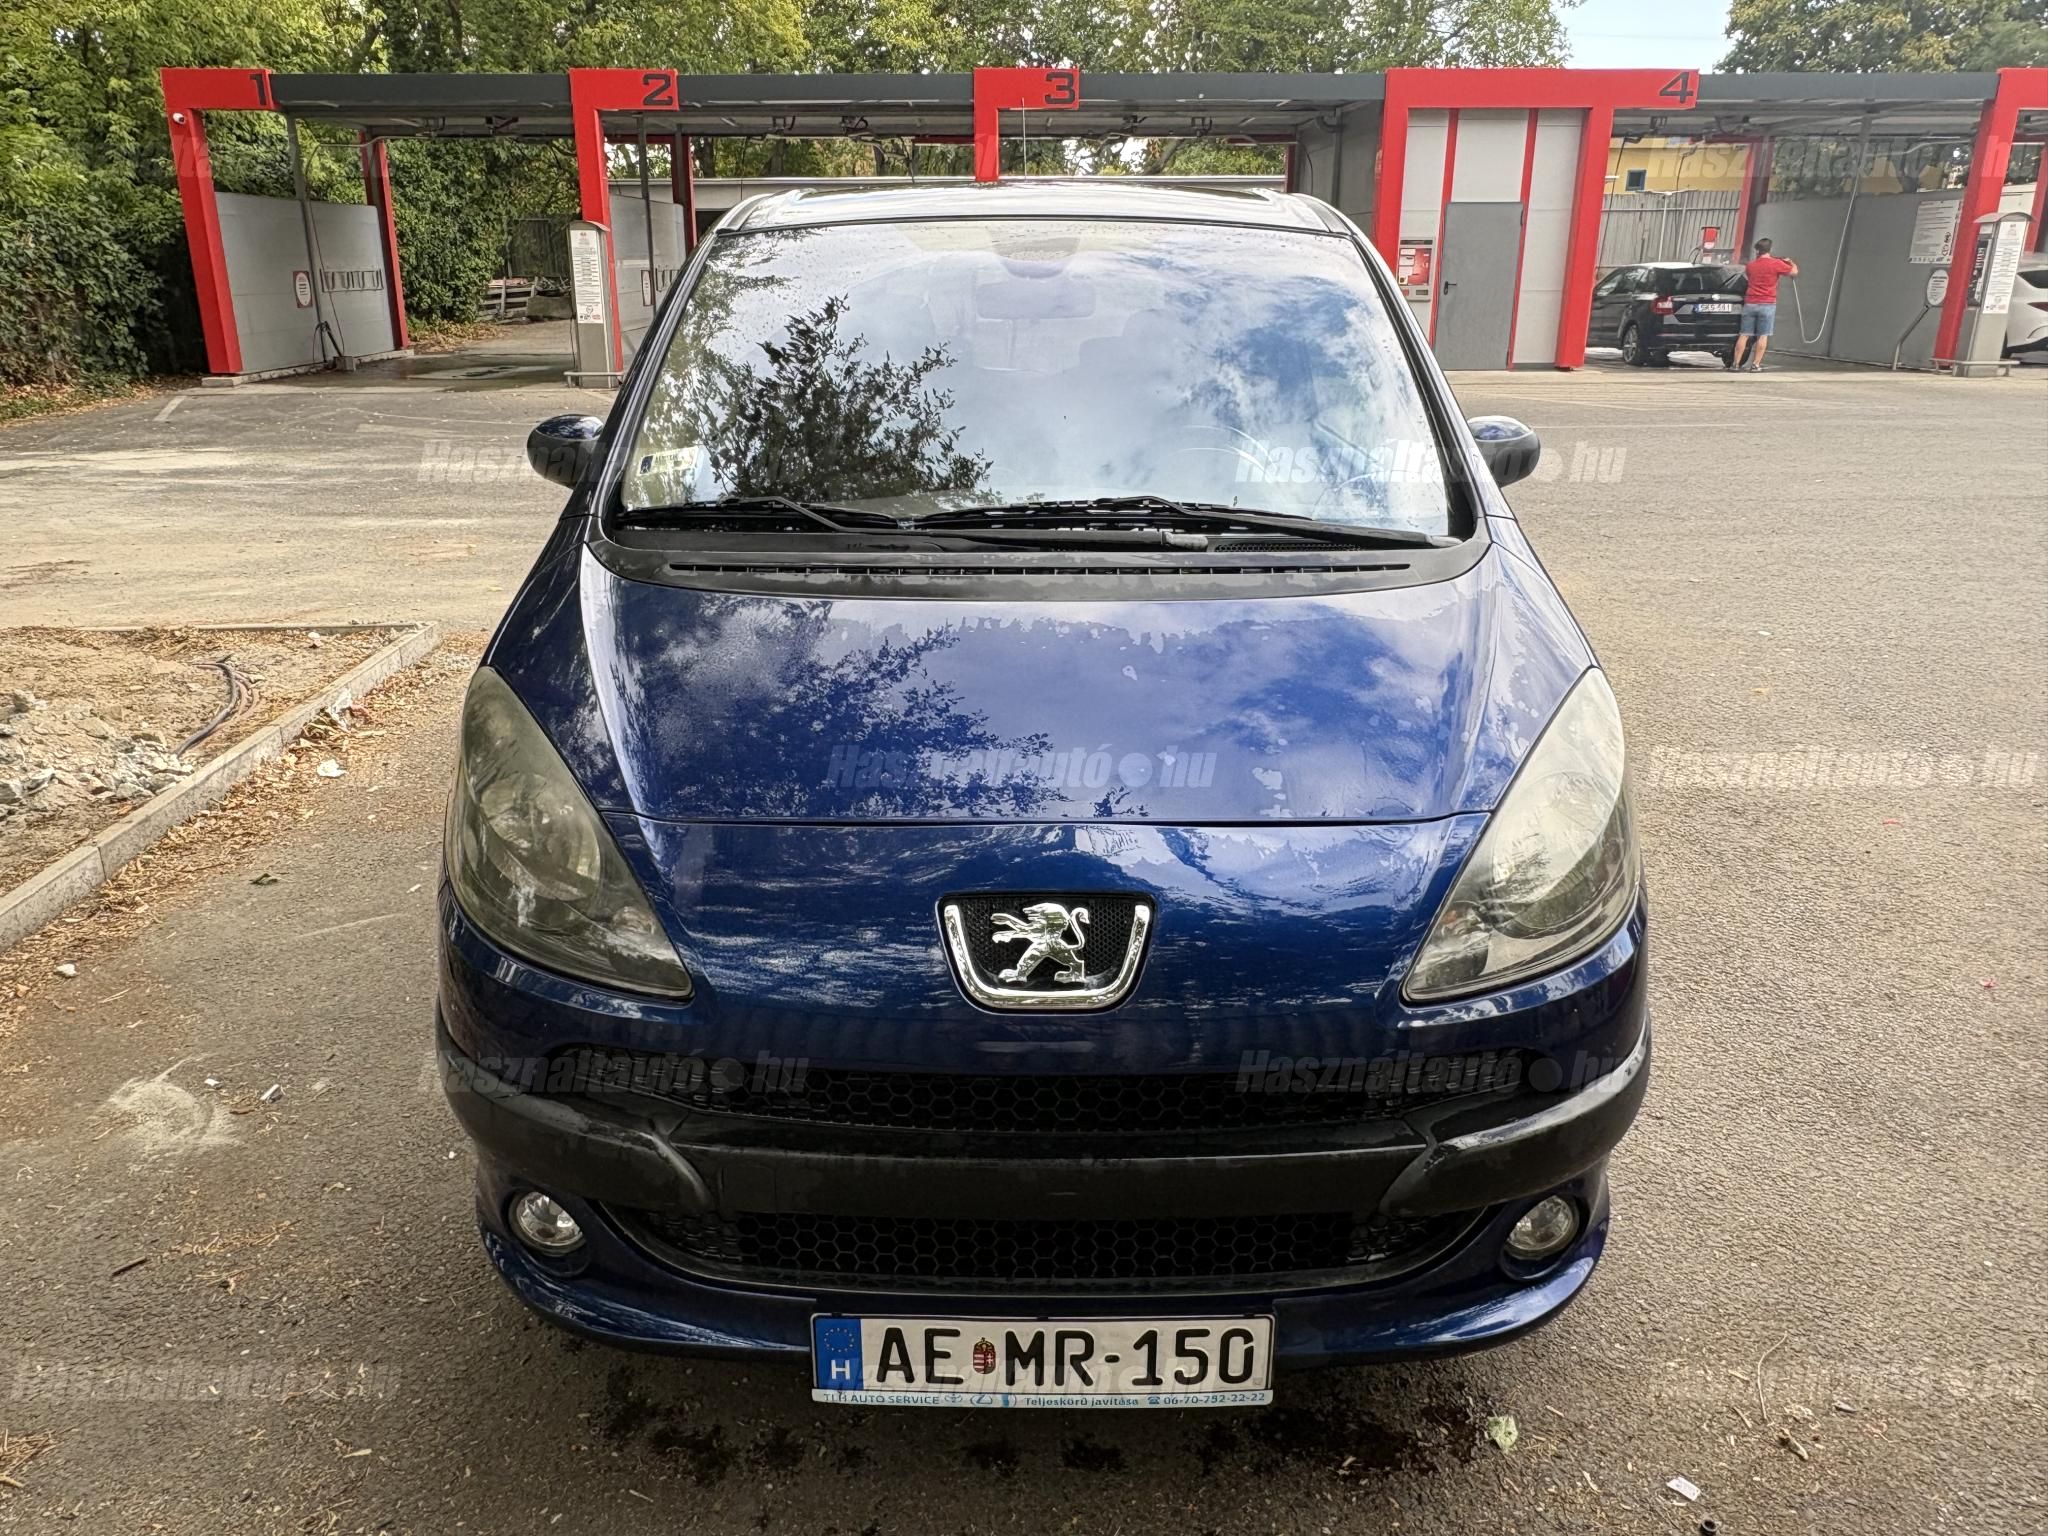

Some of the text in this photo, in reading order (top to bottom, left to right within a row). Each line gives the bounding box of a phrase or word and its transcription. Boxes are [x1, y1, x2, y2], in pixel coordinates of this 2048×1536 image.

[249, 72, 267, 106] 1
[642, 73, 673, 106] 2
[1044, 71, 1076, 105] 3
[1659, 71, 1694, 104] 4
[831, 1359, 851, 1381] H
[876, 1327, 1255, 1386] AE MR-150
[850, 1394, 885, 1404] AUTO
[888, 1395, 940, 1405] SERVICE
